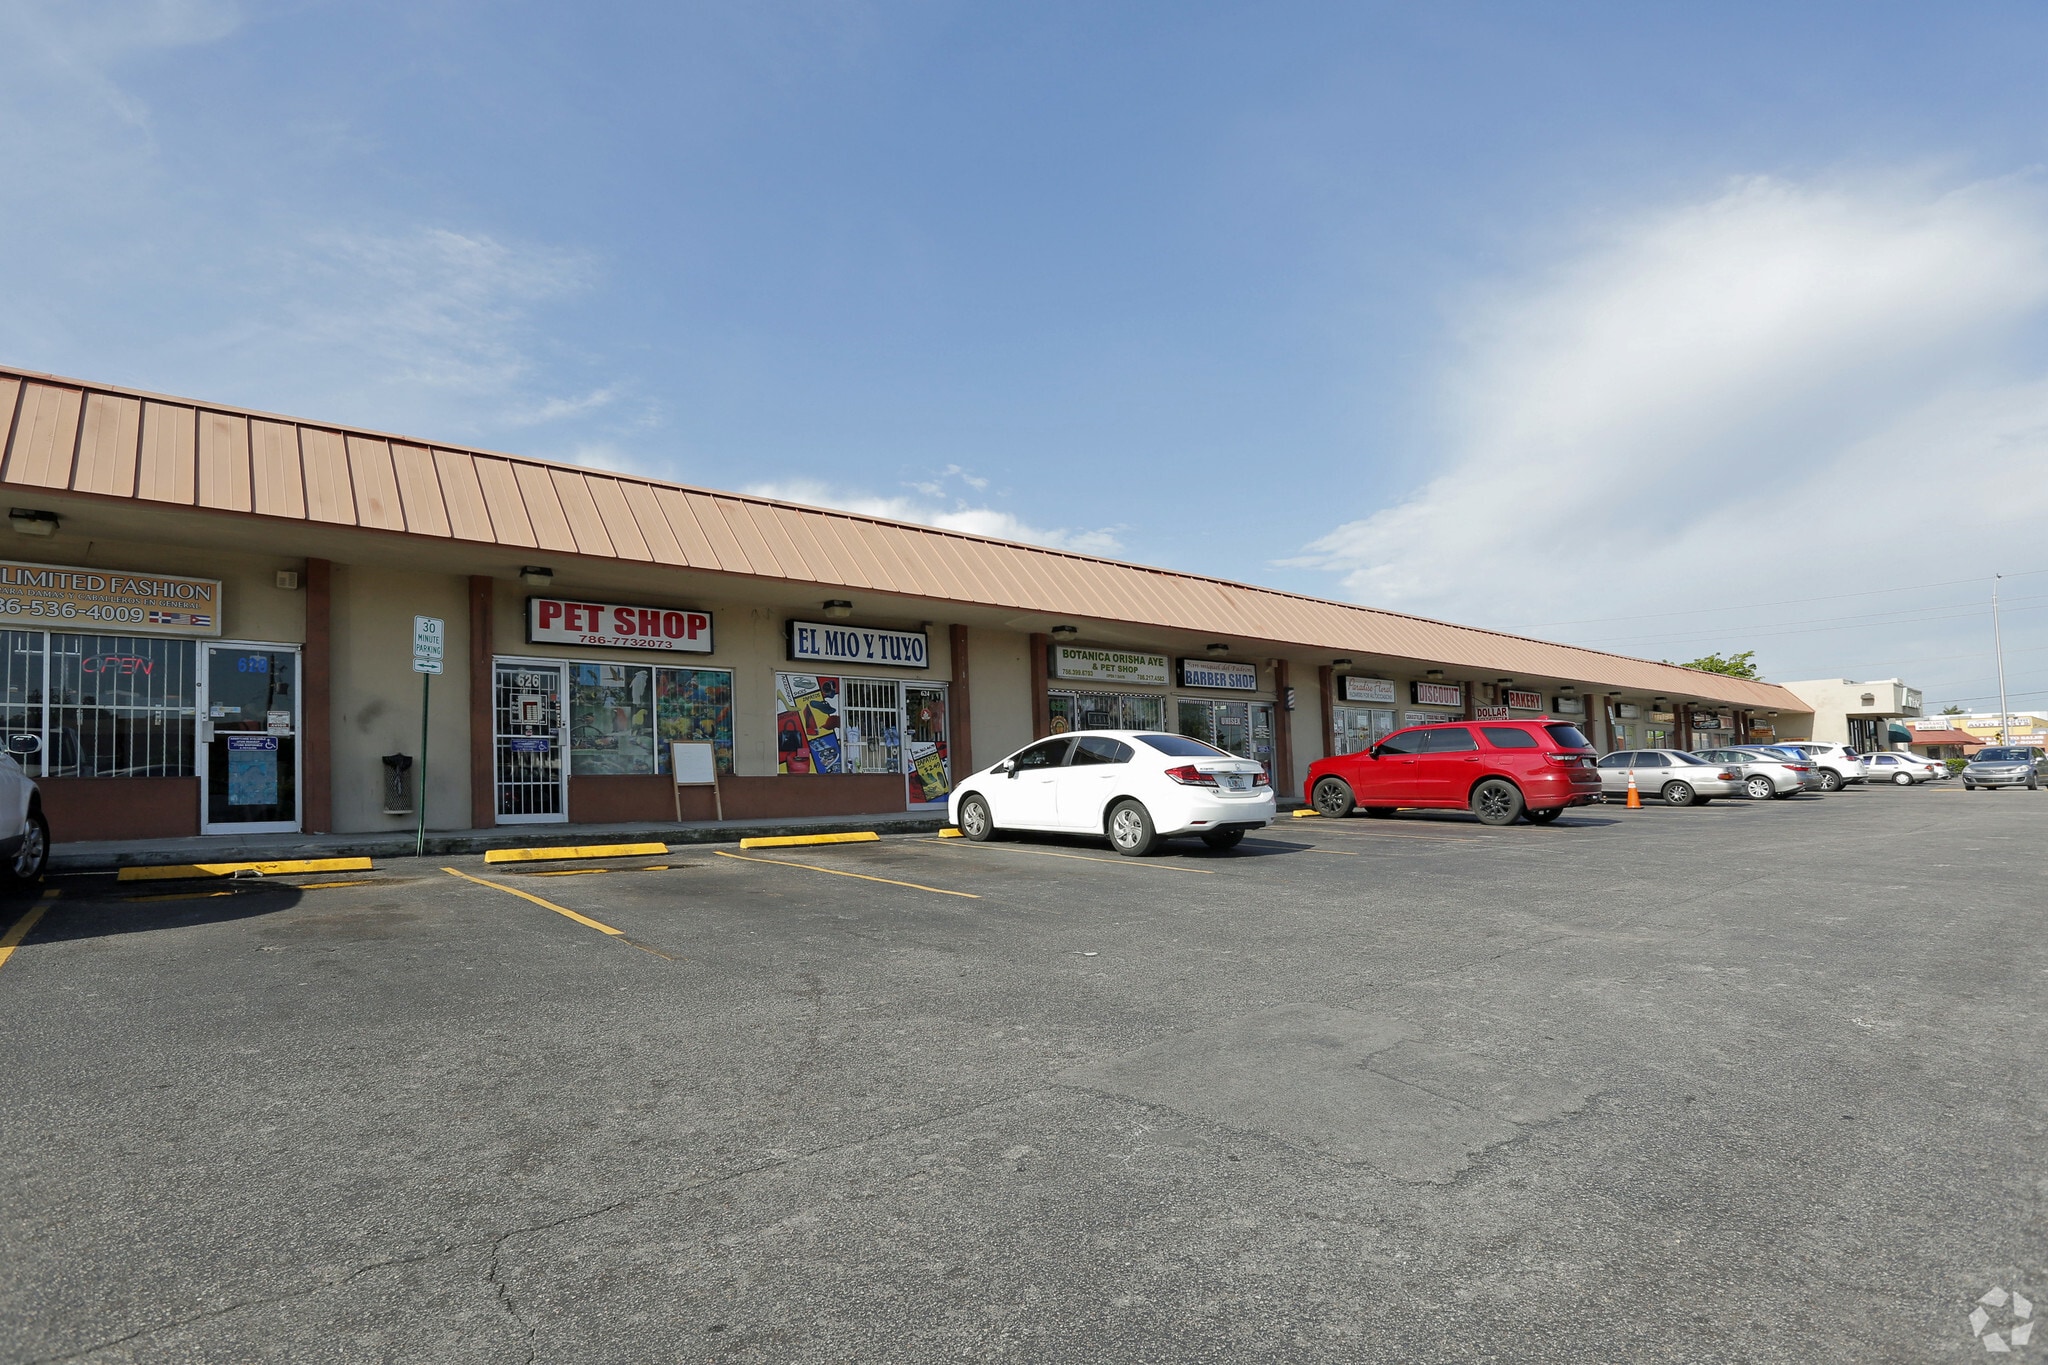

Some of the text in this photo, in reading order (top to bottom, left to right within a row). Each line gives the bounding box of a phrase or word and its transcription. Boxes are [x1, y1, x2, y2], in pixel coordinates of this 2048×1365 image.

[1, 567, 211, 601] LIMITED FASHION
[0, 587, 24, 596] ARA
[27, 588, 65, 599] DAMAS
[78, 592, 141, 605] CABALLEROS
[144, 598, 156, 606] EN
[158, 600, 200, 609] GENERAL
[422, 621, 436, 633] 30
[538, 600, 707, 640] PET SHOP
[417, 633, 440, 644] MINUTE
[578, 634, 673, 649] 786-7732073
[798, 627, 924, 662] EL MIO Y TUYO
[416, 643, 441, 655] PARKING
[1062, 648, 1164, 667] BOTANICA ORISHA AYE
[82, 656, 154, 675] OPEN
[1092, 662, 1138, 673] & PET SHOP
[517, 674, 539, 687] 626
[1185, 670, 1255, 688] BARBER SHOP
[1418, 684, 1459, 704] DISCOUNT
[1509, 692, 1540, 709] BAKERY
[1477, 707, 1507, 717] DOLLAR
